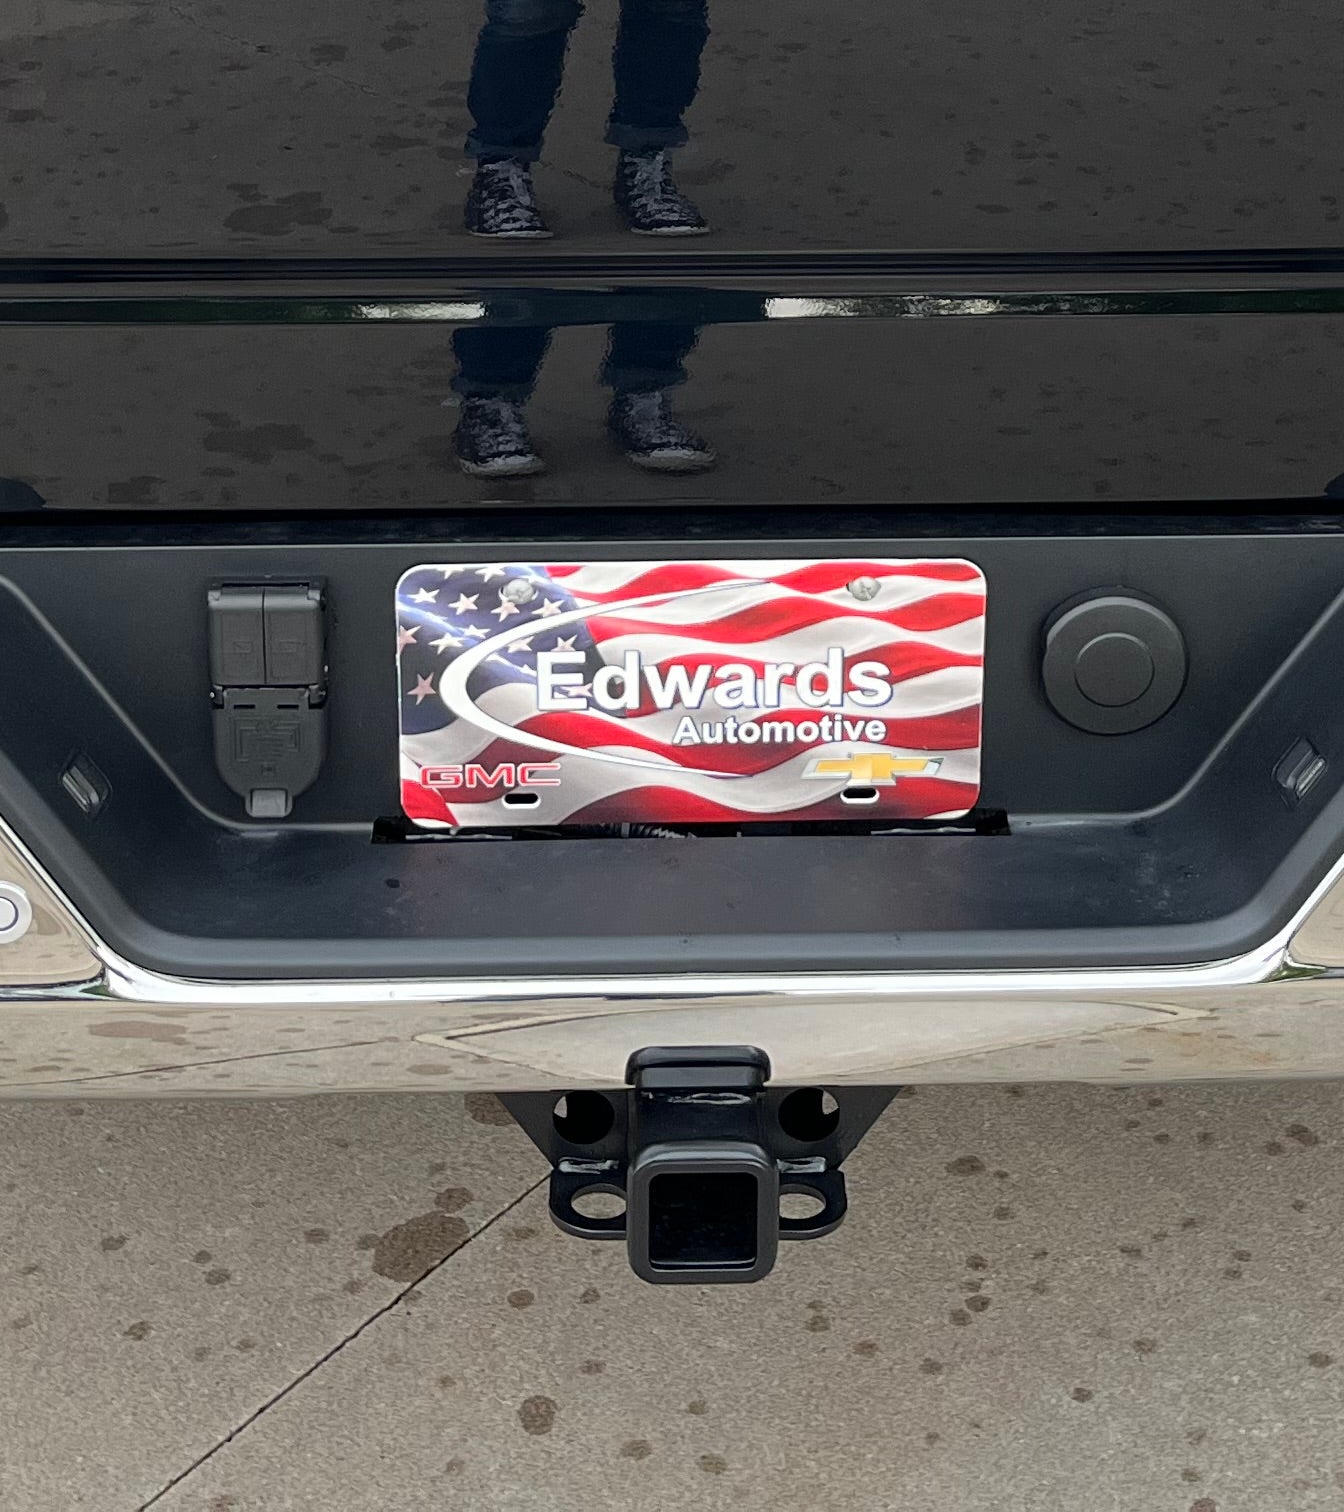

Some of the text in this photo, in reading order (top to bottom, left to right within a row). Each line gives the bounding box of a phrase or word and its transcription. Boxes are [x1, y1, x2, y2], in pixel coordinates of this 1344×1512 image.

[536, 648, 893, 711] Edwards
[673, 715, 887, 745] Automotive
[420, 762, 562, 789] GMC
